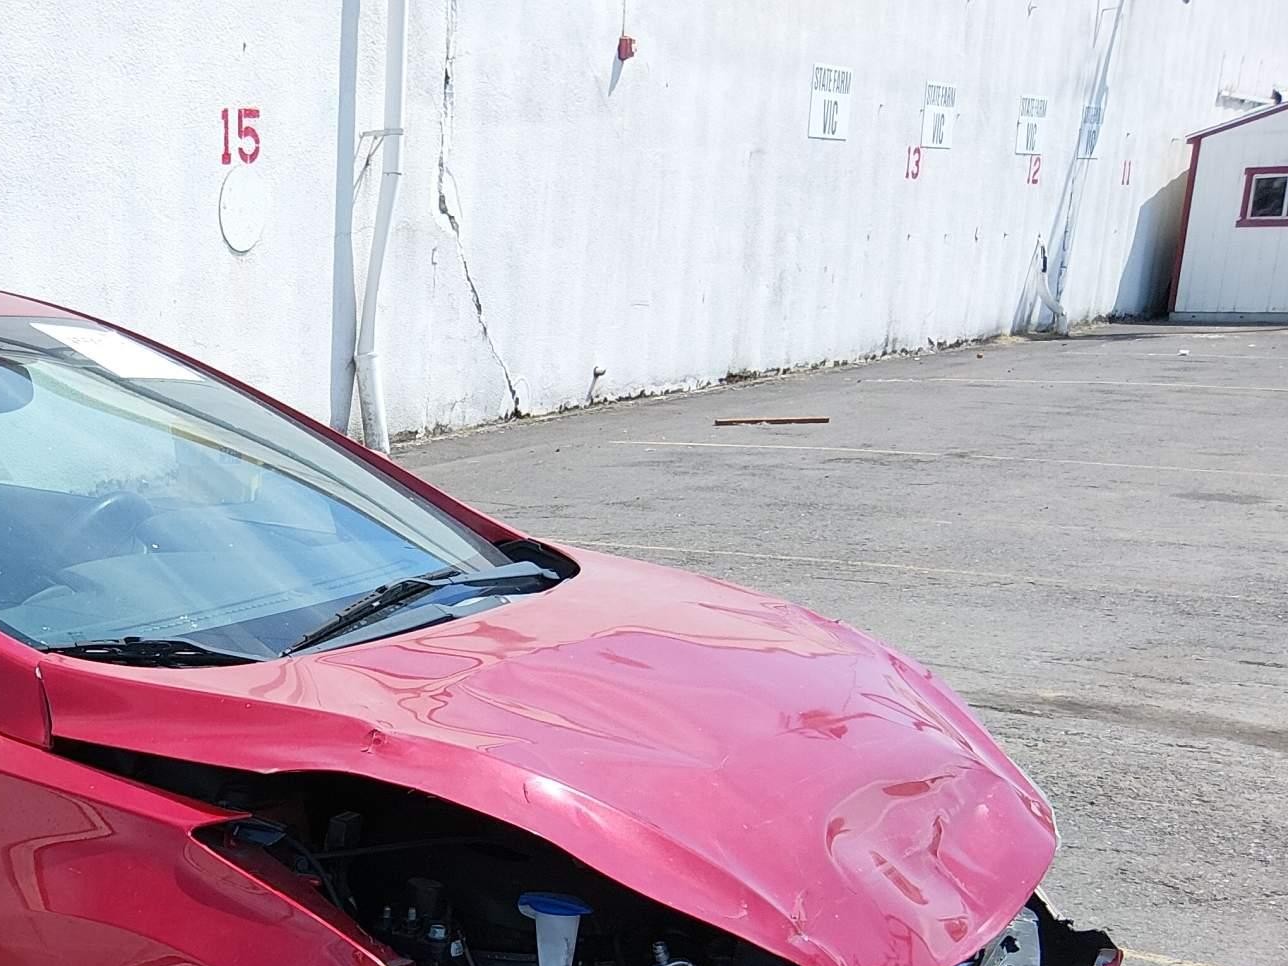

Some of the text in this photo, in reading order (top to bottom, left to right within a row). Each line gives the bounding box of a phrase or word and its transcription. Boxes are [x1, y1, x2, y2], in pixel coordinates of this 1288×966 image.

[814, 66, 851, 94] STATE FARM
[823, 99, 839, 135] VIC
[932, 112, 945, 144] VIC
[220, 108, 261, 165] 15
[905, 146, 921, 179] 13
[1027, 155, 1041, 184] 12
[1121, 160, 1131, 185] 11
